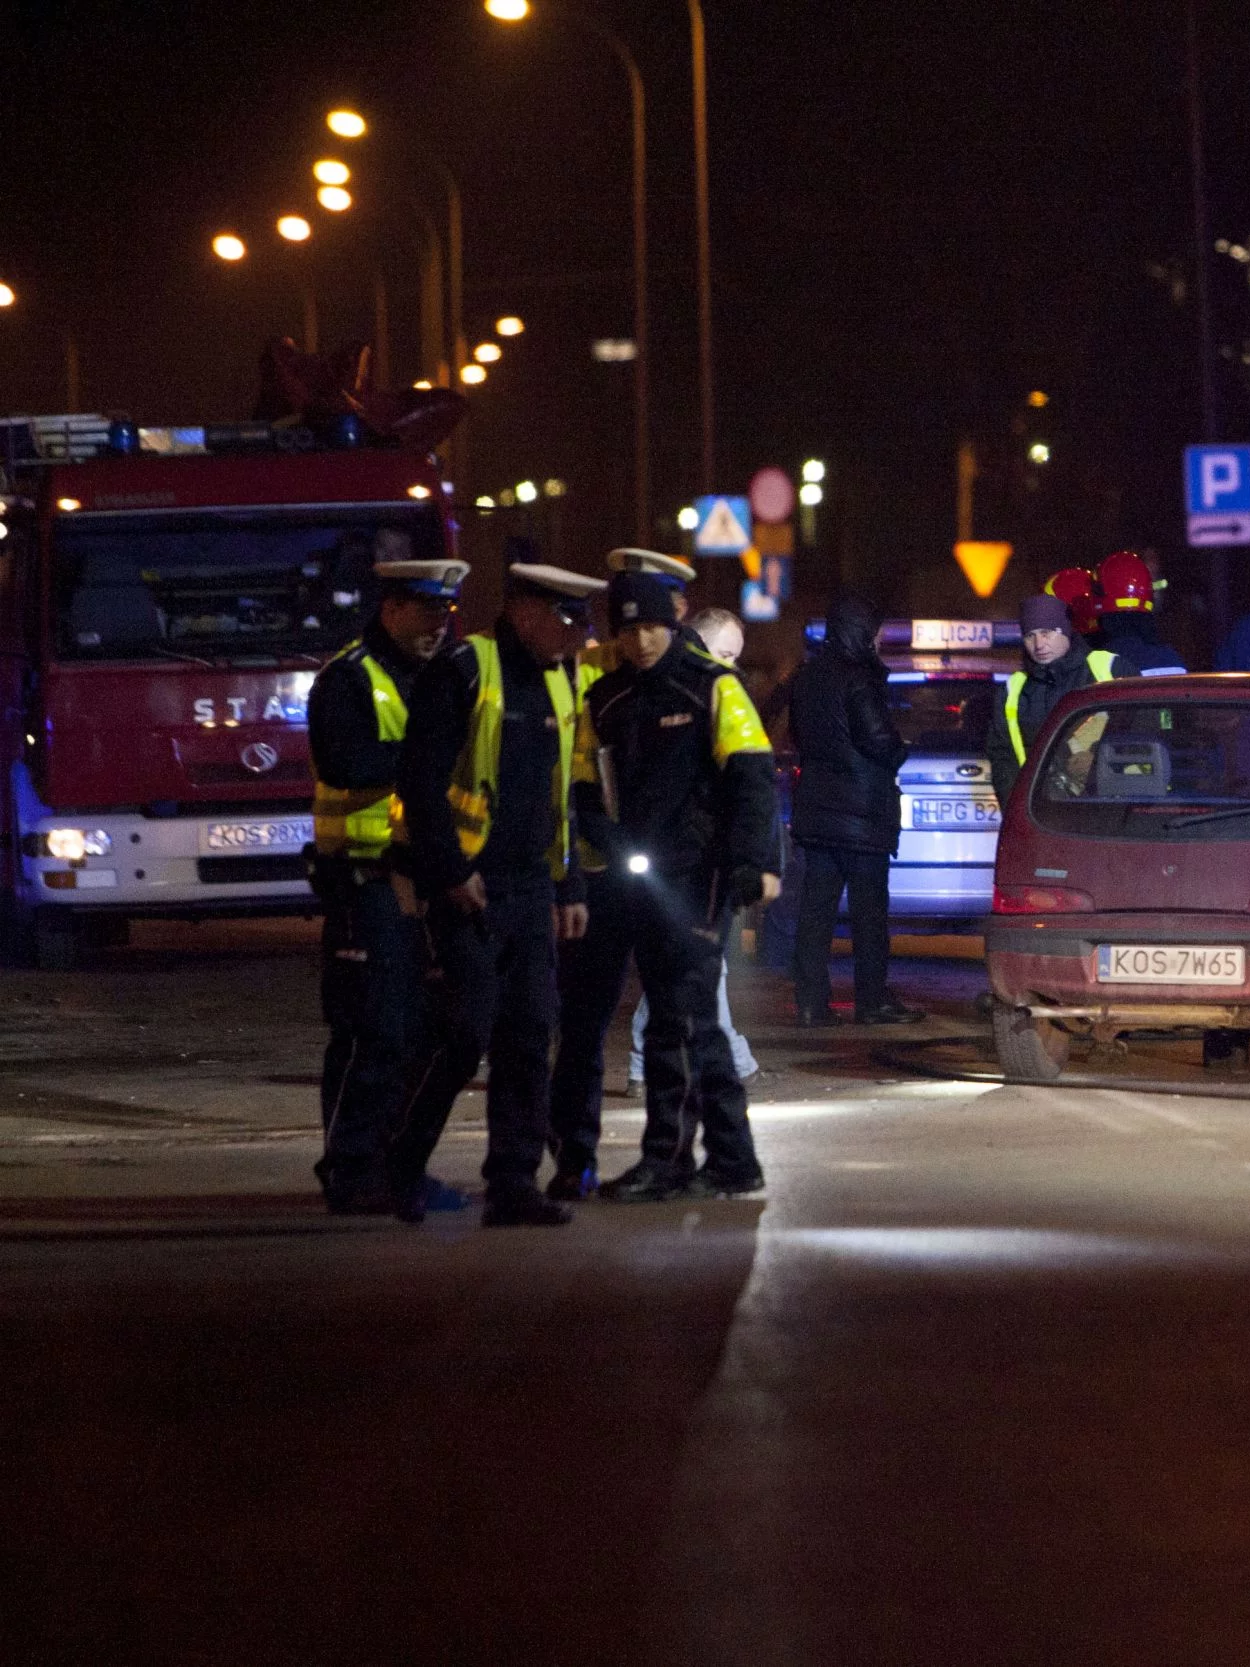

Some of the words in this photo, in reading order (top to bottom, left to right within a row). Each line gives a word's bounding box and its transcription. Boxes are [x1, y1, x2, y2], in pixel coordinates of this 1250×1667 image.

[1203, 454, 1240, 507] P
[1114, 949, 1167, 975] KOS
[1177, 950, 1238, 976] 7W65
